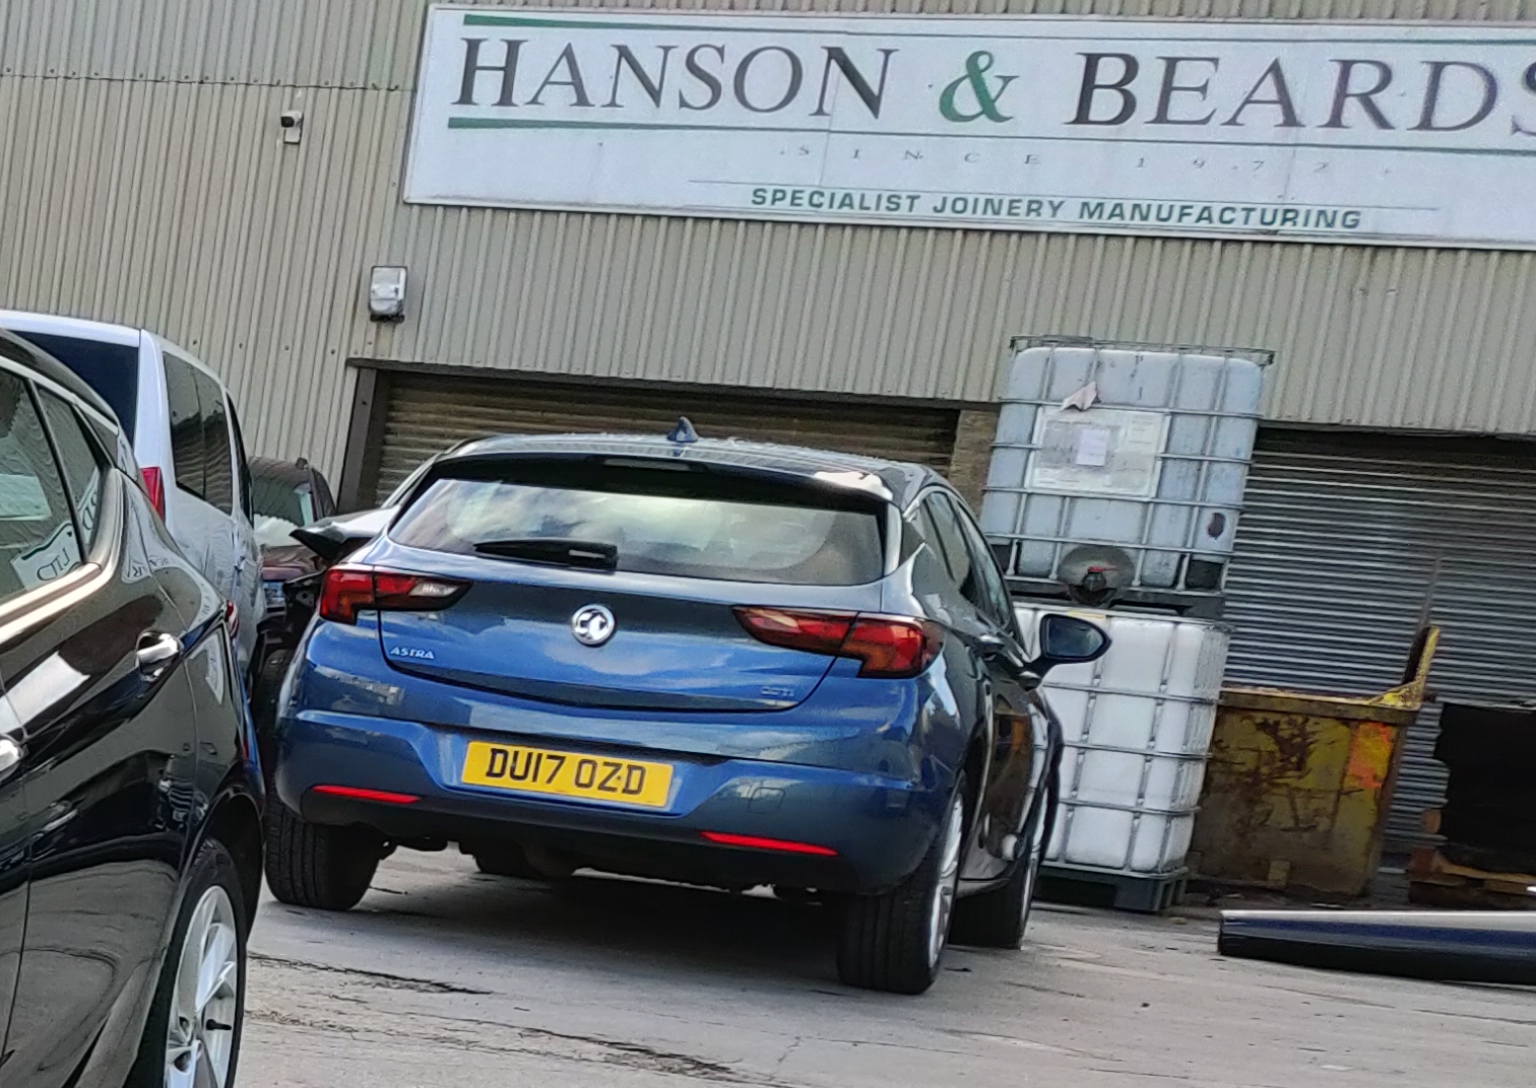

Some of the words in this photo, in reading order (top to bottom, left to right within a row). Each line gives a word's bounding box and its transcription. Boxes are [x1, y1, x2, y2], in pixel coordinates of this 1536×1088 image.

[452, 37, 899, 119] HANSON
[939, 50, 1020, 123] &
[798, 145, 1040, 165] SINCE
[751, 187, 922, 214] SPECIALIST
[932, 196, 1066, 220] JOINERY
[1078, 200, 1362, 230] MANUFACTURING
[389, 646, 436, 660] ASTRA
[485, 747, 567, 785] DU17
[574, 758, 647, 796] OZD
